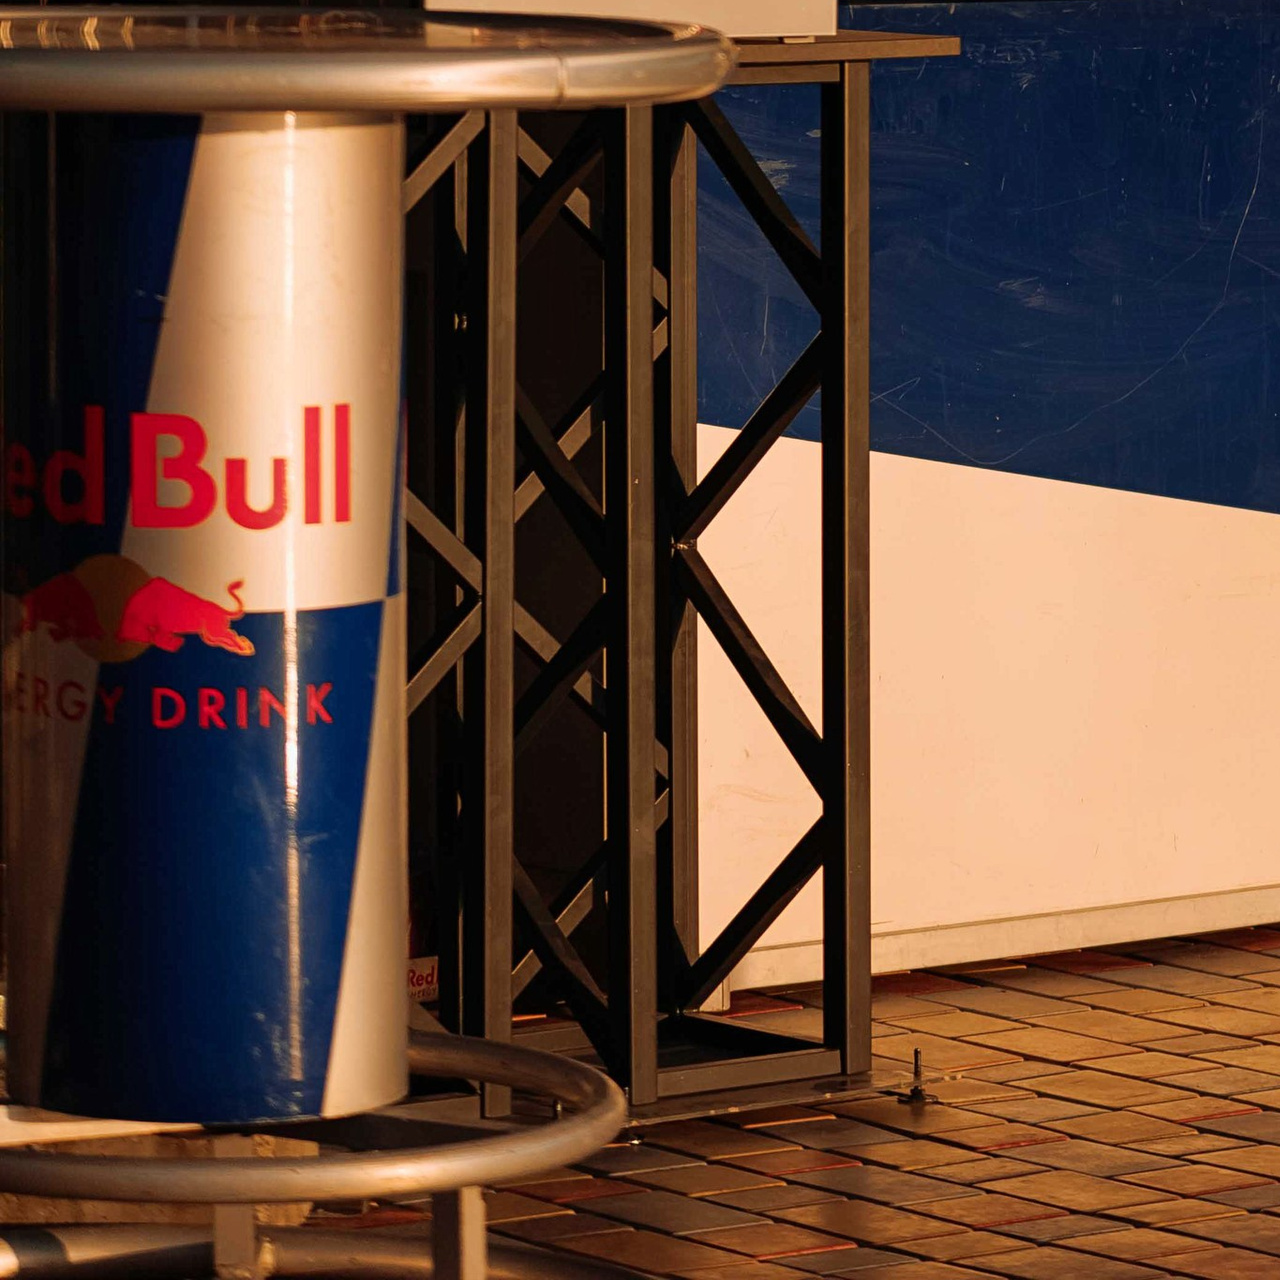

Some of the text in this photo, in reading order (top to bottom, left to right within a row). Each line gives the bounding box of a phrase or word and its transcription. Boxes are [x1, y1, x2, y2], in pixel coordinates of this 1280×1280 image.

[5, 403, 352, 530] ed Bull
[15, 671, 334, 730] ERGY DRINK
